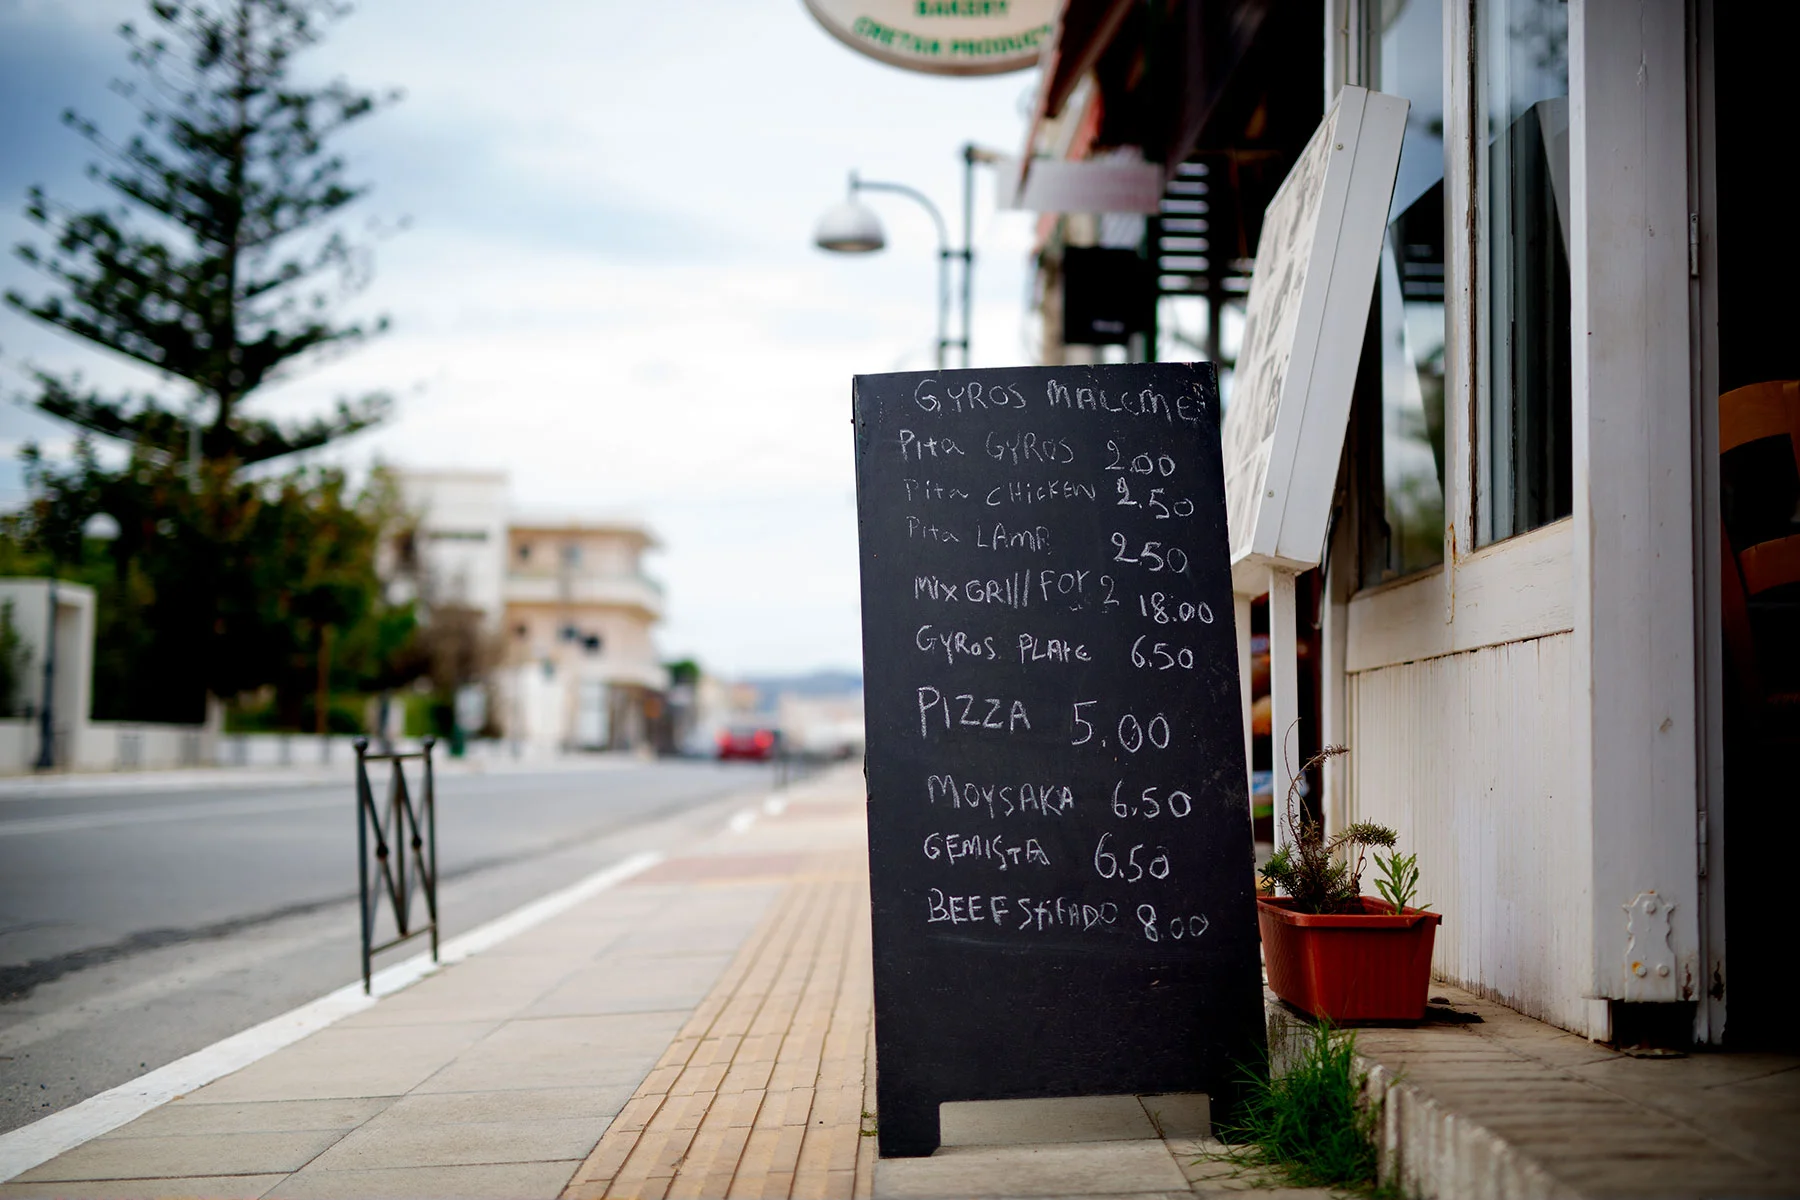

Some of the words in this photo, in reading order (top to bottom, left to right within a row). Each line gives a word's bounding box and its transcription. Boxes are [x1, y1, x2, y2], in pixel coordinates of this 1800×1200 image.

[914, 378, 1027, 412] GYROS
[985, 431, 1075, 465] GYROS
[1104, 439, 1176, 477] 2.00
[1100, 575, 1120, 606] 2
[1131, 634, 1194, 669] 6.50
[916, 686, 1032, 740] PIZZA
[927, 774, 1076, 819] MOYSAKA
[1095, 831, 1171, 883] 6.50
[927, 887, 1010, 926] BEEF
